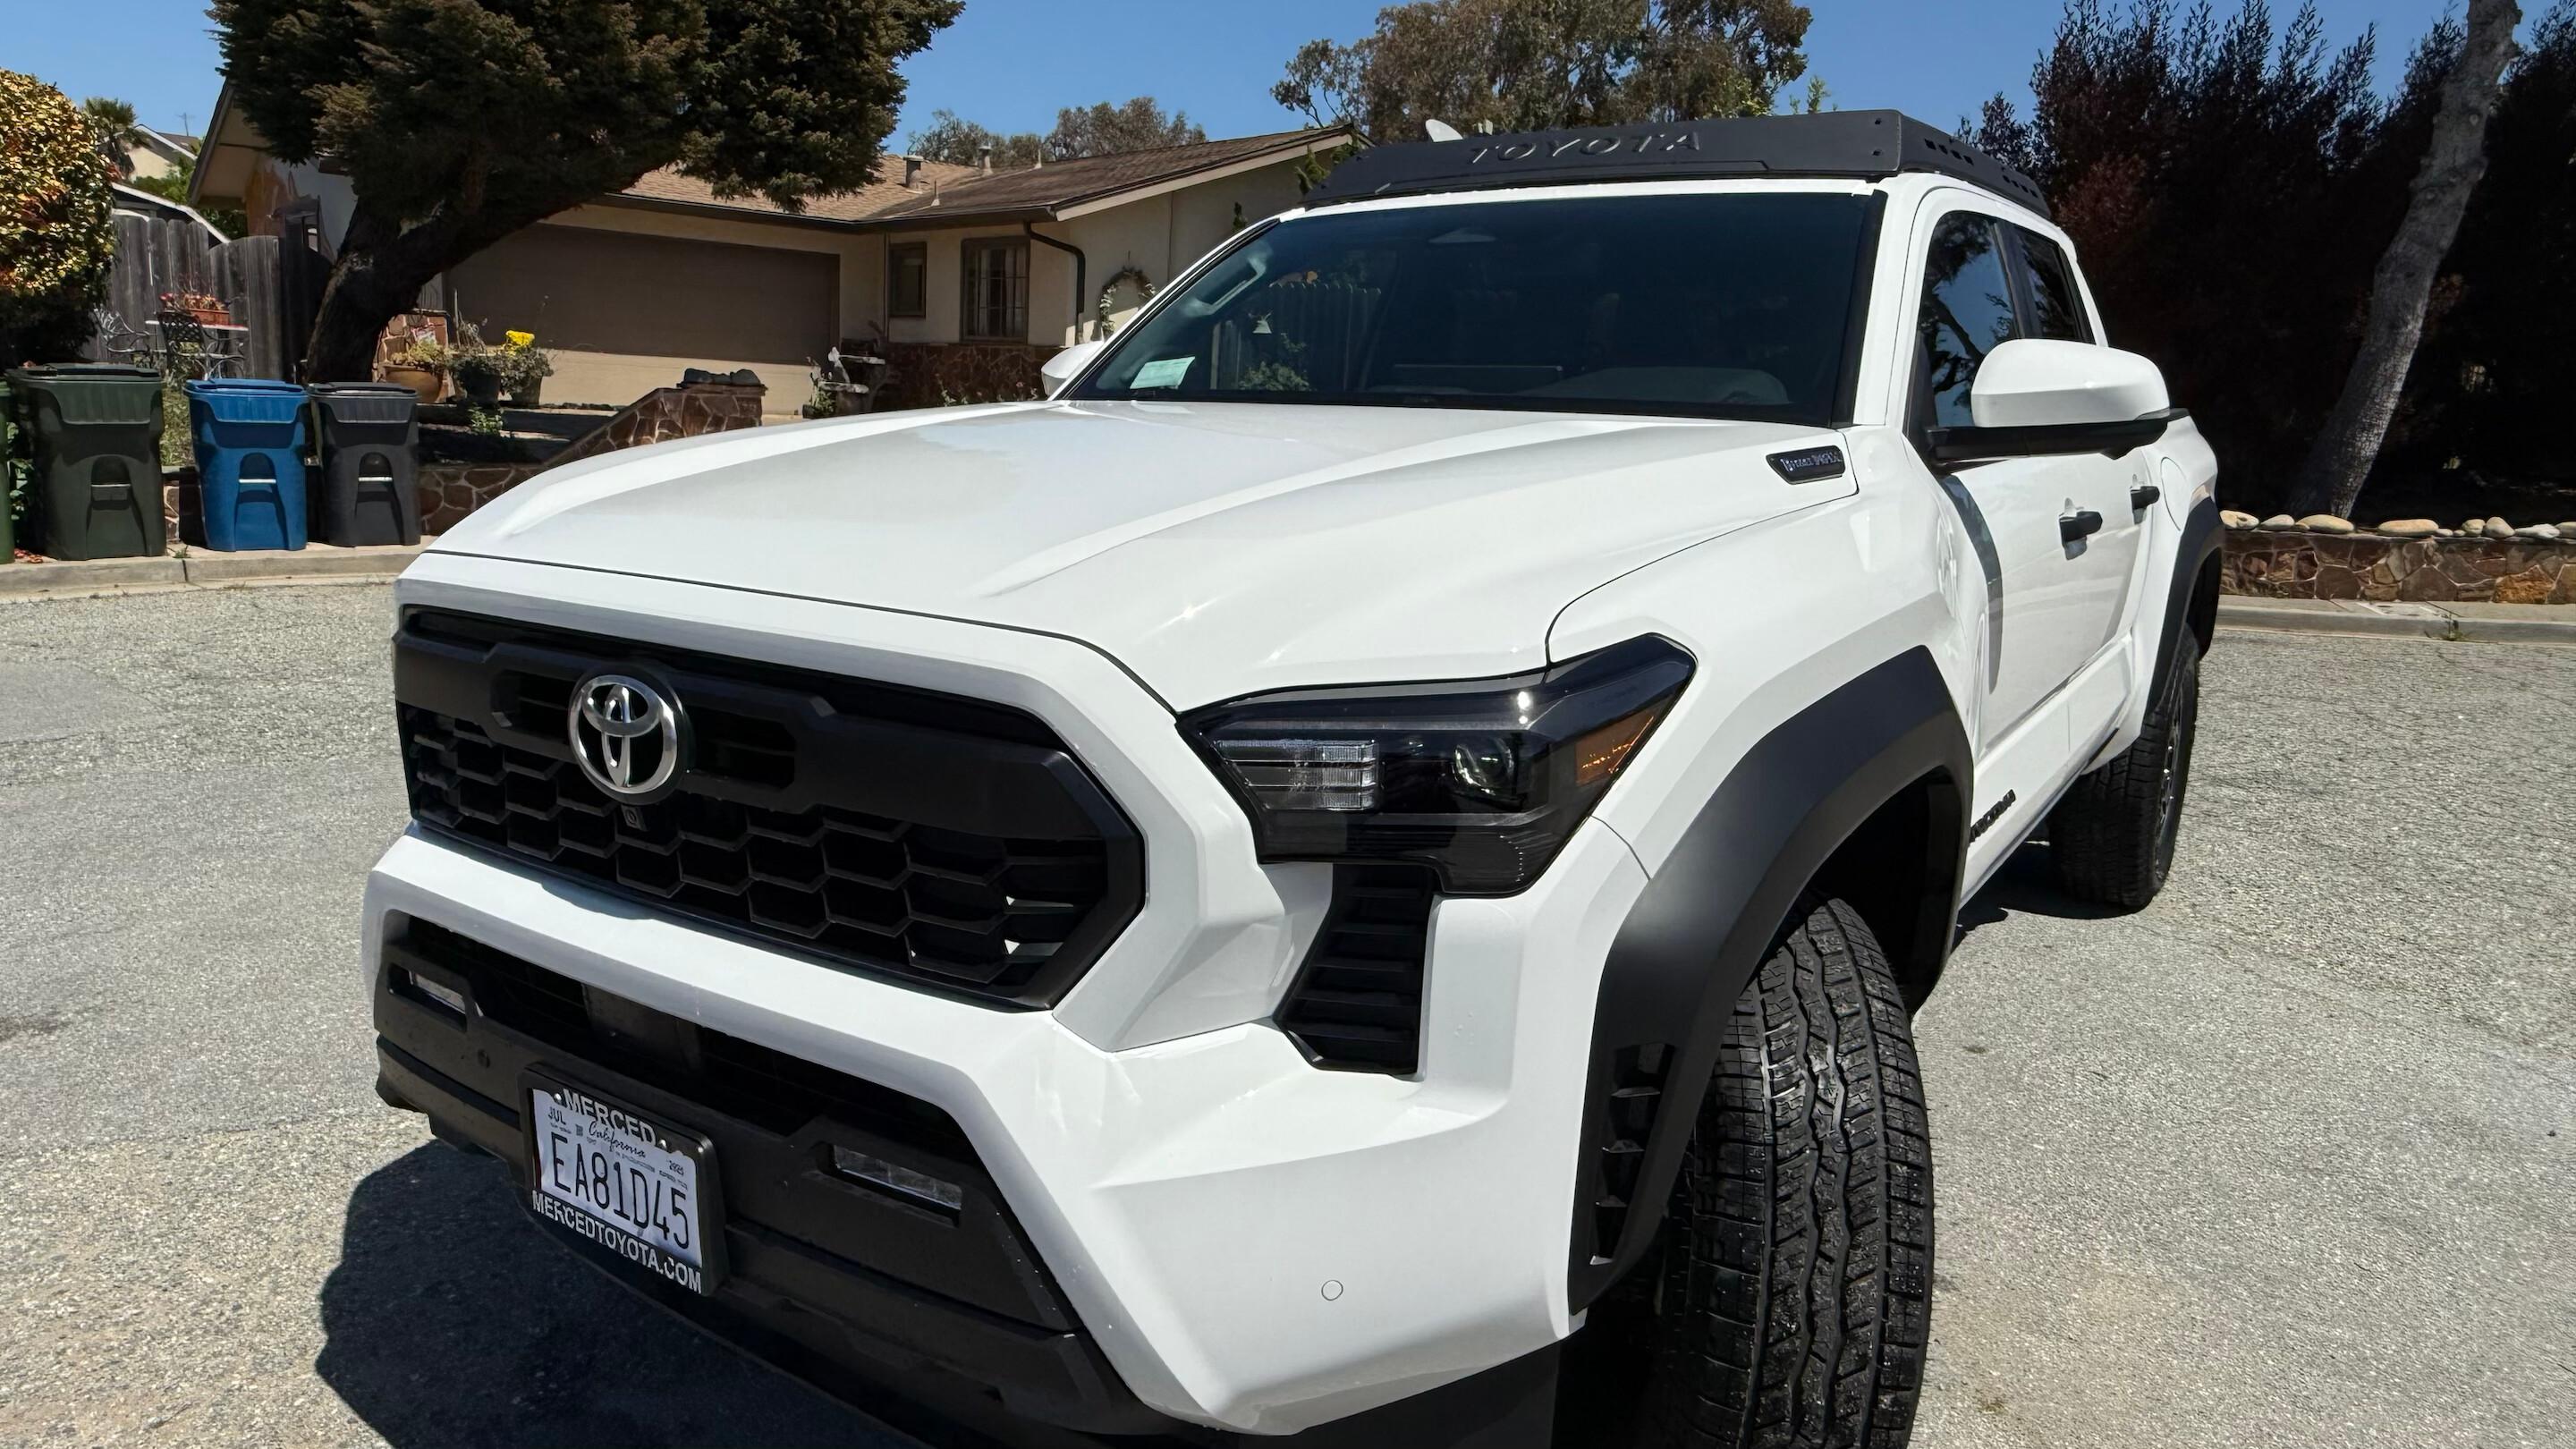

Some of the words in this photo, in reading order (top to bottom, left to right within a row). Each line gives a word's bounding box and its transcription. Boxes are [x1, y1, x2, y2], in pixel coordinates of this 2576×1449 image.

[1468, 131, 1699, 164] TOYOTA
[548, 1106, 566, 1125] JUL
[563, 1089, 656, 1147] MERCED
[589, 1120, 646, 1158] California
[551, 1131, 689, 1250] EA81D45
[532, 1190, 702, 1294] MERCEDTOYOTA.COM
